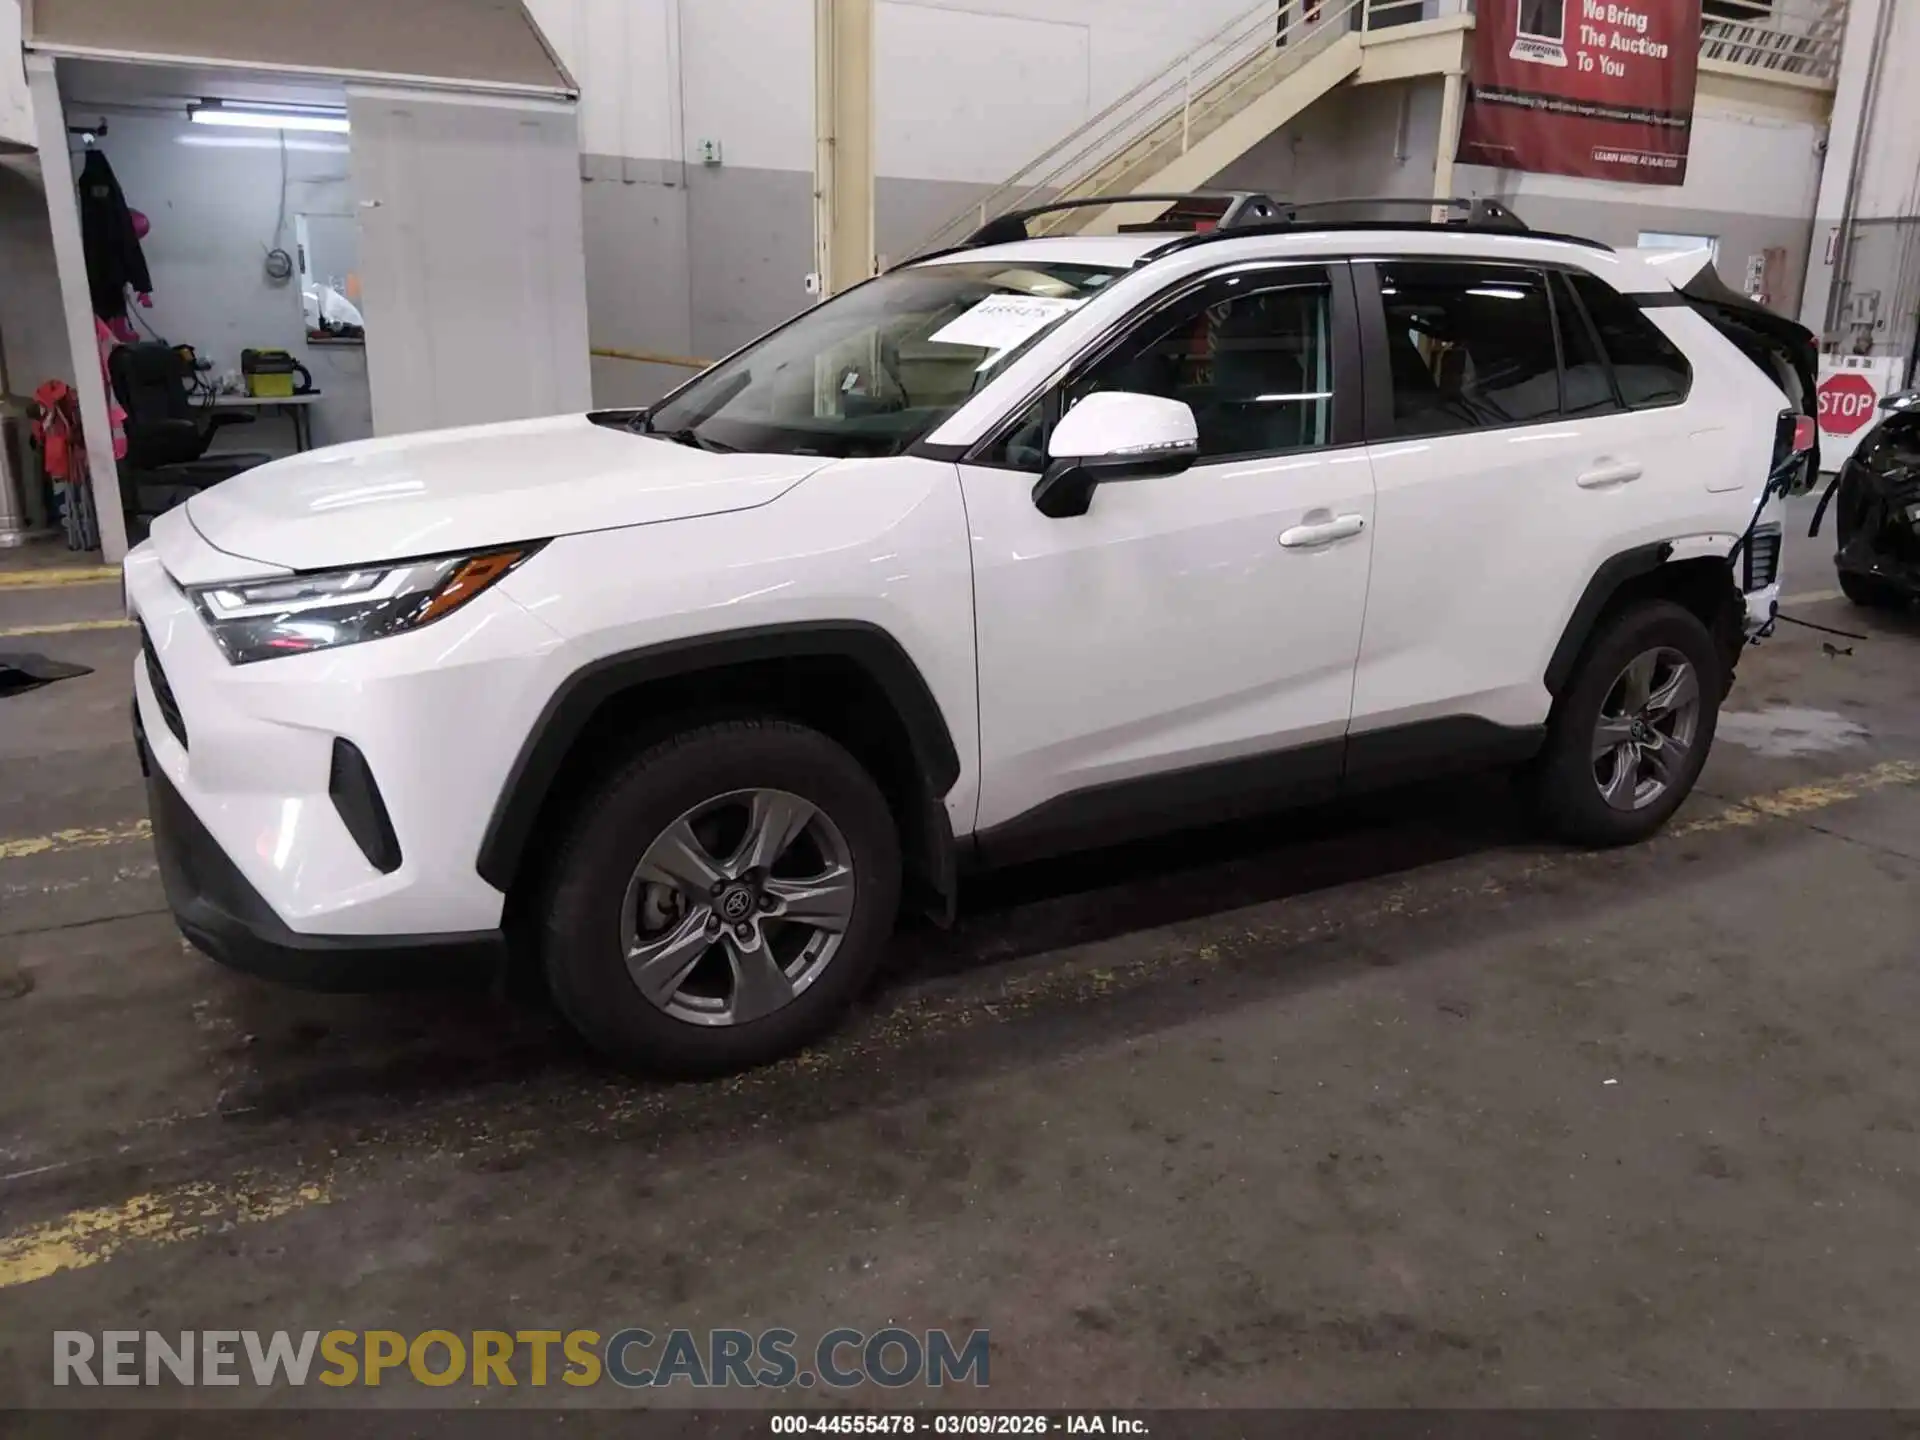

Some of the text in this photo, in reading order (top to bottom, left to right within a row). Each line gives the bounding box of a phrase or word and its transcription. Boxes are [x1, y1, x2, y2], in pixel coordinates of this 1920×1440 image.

[1583, 0, 1648, 34] We Bring
[1580, 24, 1669, 59] The Auction
[1577, 50, 1625, 77] To You
[1818, 391, 1873, 416] STOP
